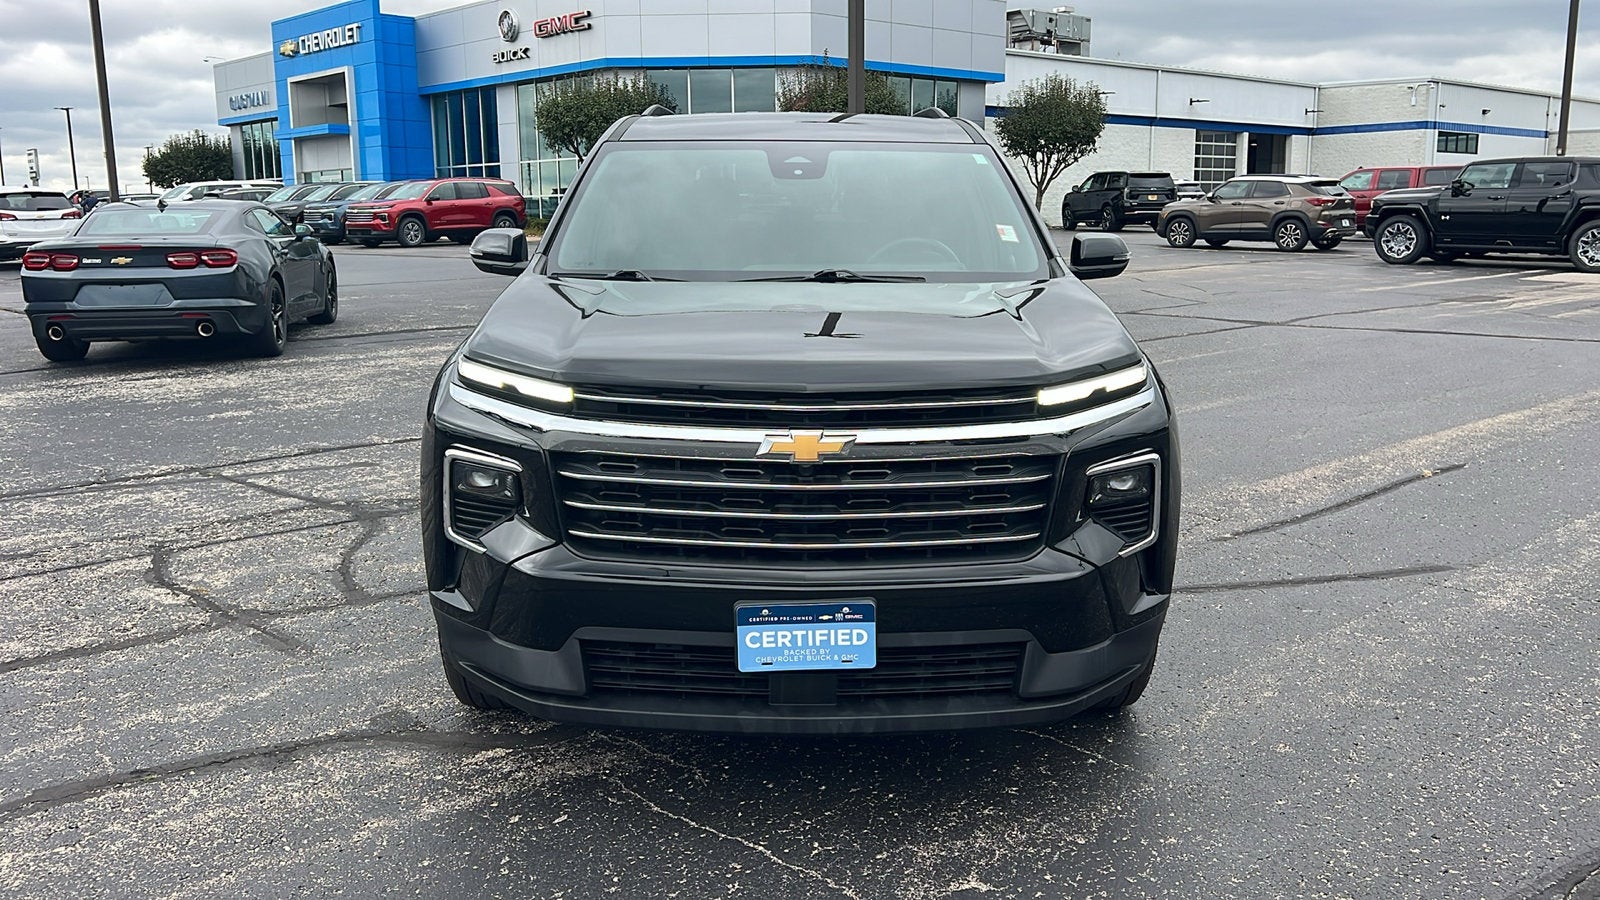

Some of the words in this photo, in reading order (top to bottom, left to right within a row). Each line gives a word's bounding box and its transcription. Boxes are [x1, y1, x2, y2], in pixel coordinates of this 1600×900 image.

[533, 10, 592, 38] GMC
[298, 22, 362, 55] CHEVROLET
[492, 47, 530, 63] BUICK
[745, 629, 868, 649] CERTIFIED
[755, 655, 804, 663] CHEVROLET
[806, 654, 832, 662] BUICK
[841, 653, 859, 661] GMC
[783, 648, 817, 656] BACKED
